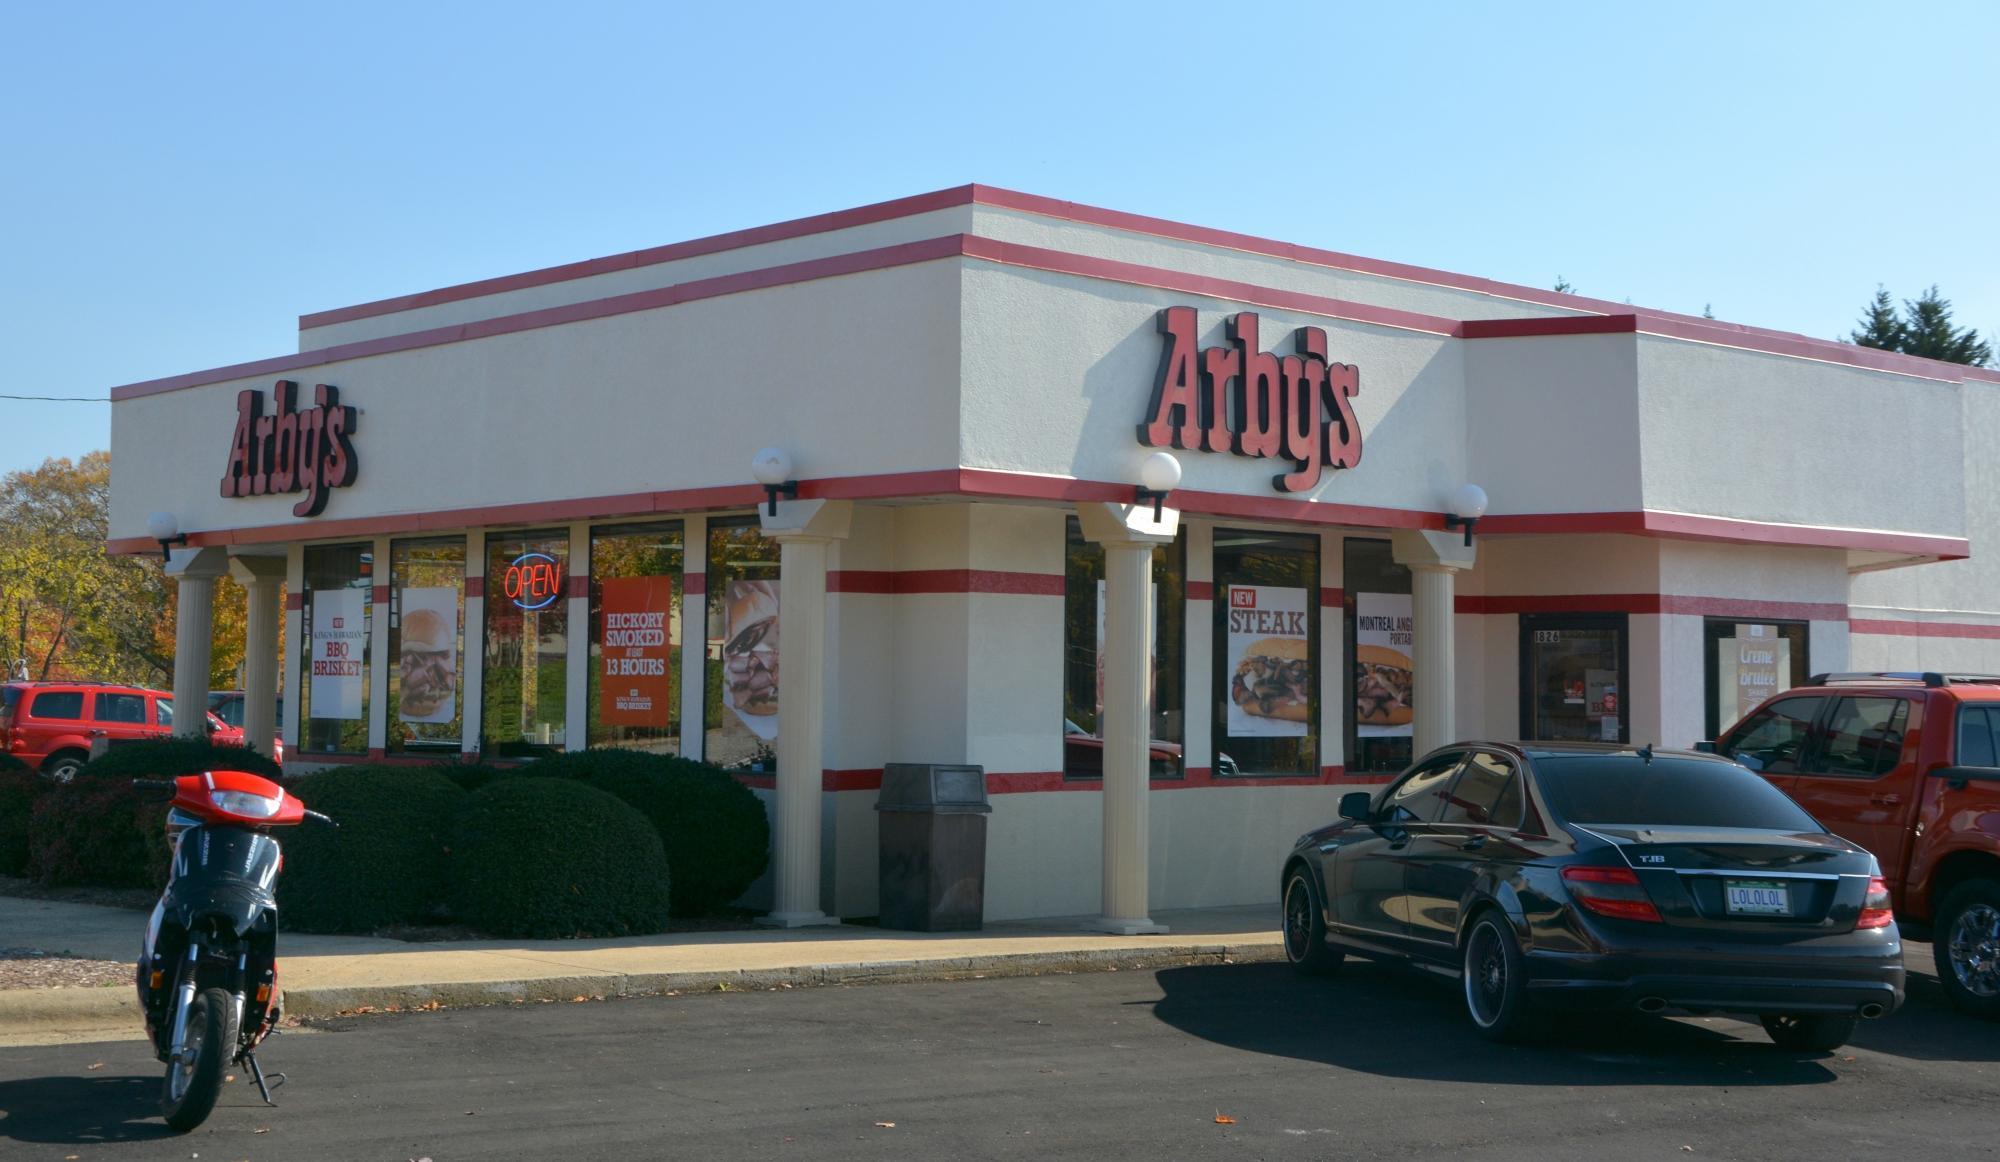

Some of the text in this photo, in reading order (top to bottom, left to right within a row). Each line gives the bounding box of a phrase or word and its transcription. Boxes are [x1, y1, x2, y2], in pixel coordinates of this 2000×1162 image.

[1137, 305, 1363, 492] Arby's
[221, 380, 359, 518] Arby's
[505, 562, 561, 598] OPEN
[1233, 591, 1254, 606] NEW
[607, 612, 665, 629] HICKORY
[1230, 609, 1305, 636] STEAK
[1359, 615, 1395, 631] MONTREAL
[606, 629, 665, 647] SMOKED
[1535, 631, 1560, 642] 1826
[326, 641, 349, 660] BBQ
[313, 660, 361, 675] BRISKET
[606, 658, 665, 676] 13 HOURS
[1731, 889, 1784, 906] LOLOLOL
